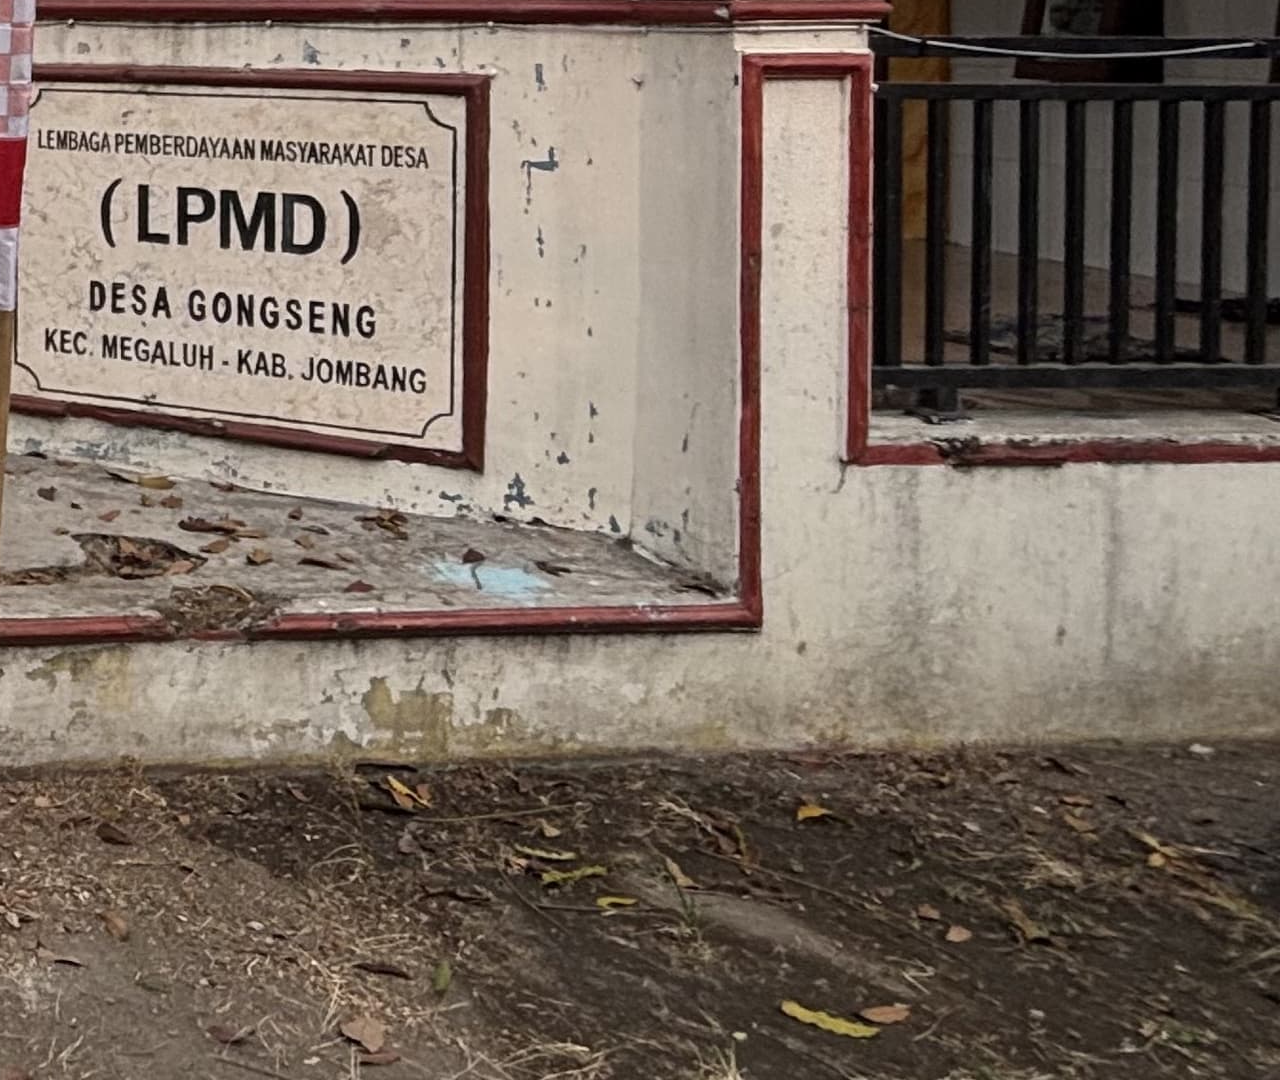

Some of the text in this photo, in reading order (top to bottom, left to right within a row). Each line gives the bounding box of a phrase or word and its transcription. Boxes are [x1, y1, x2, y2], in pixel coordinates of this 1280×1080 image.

[37, 129, 429, 169] LEMBAGA PEMBERDAYAAN MASYARAKAT DESA
[89, 280, 376, 338] DESA GONGSENG
[44, 327, 94, 357] KEC.
[101, 334, 214, 371] MEGALUH
[236, 349, 294, 380] KAB.
[300, 356, 427, 394] JOMBANG
